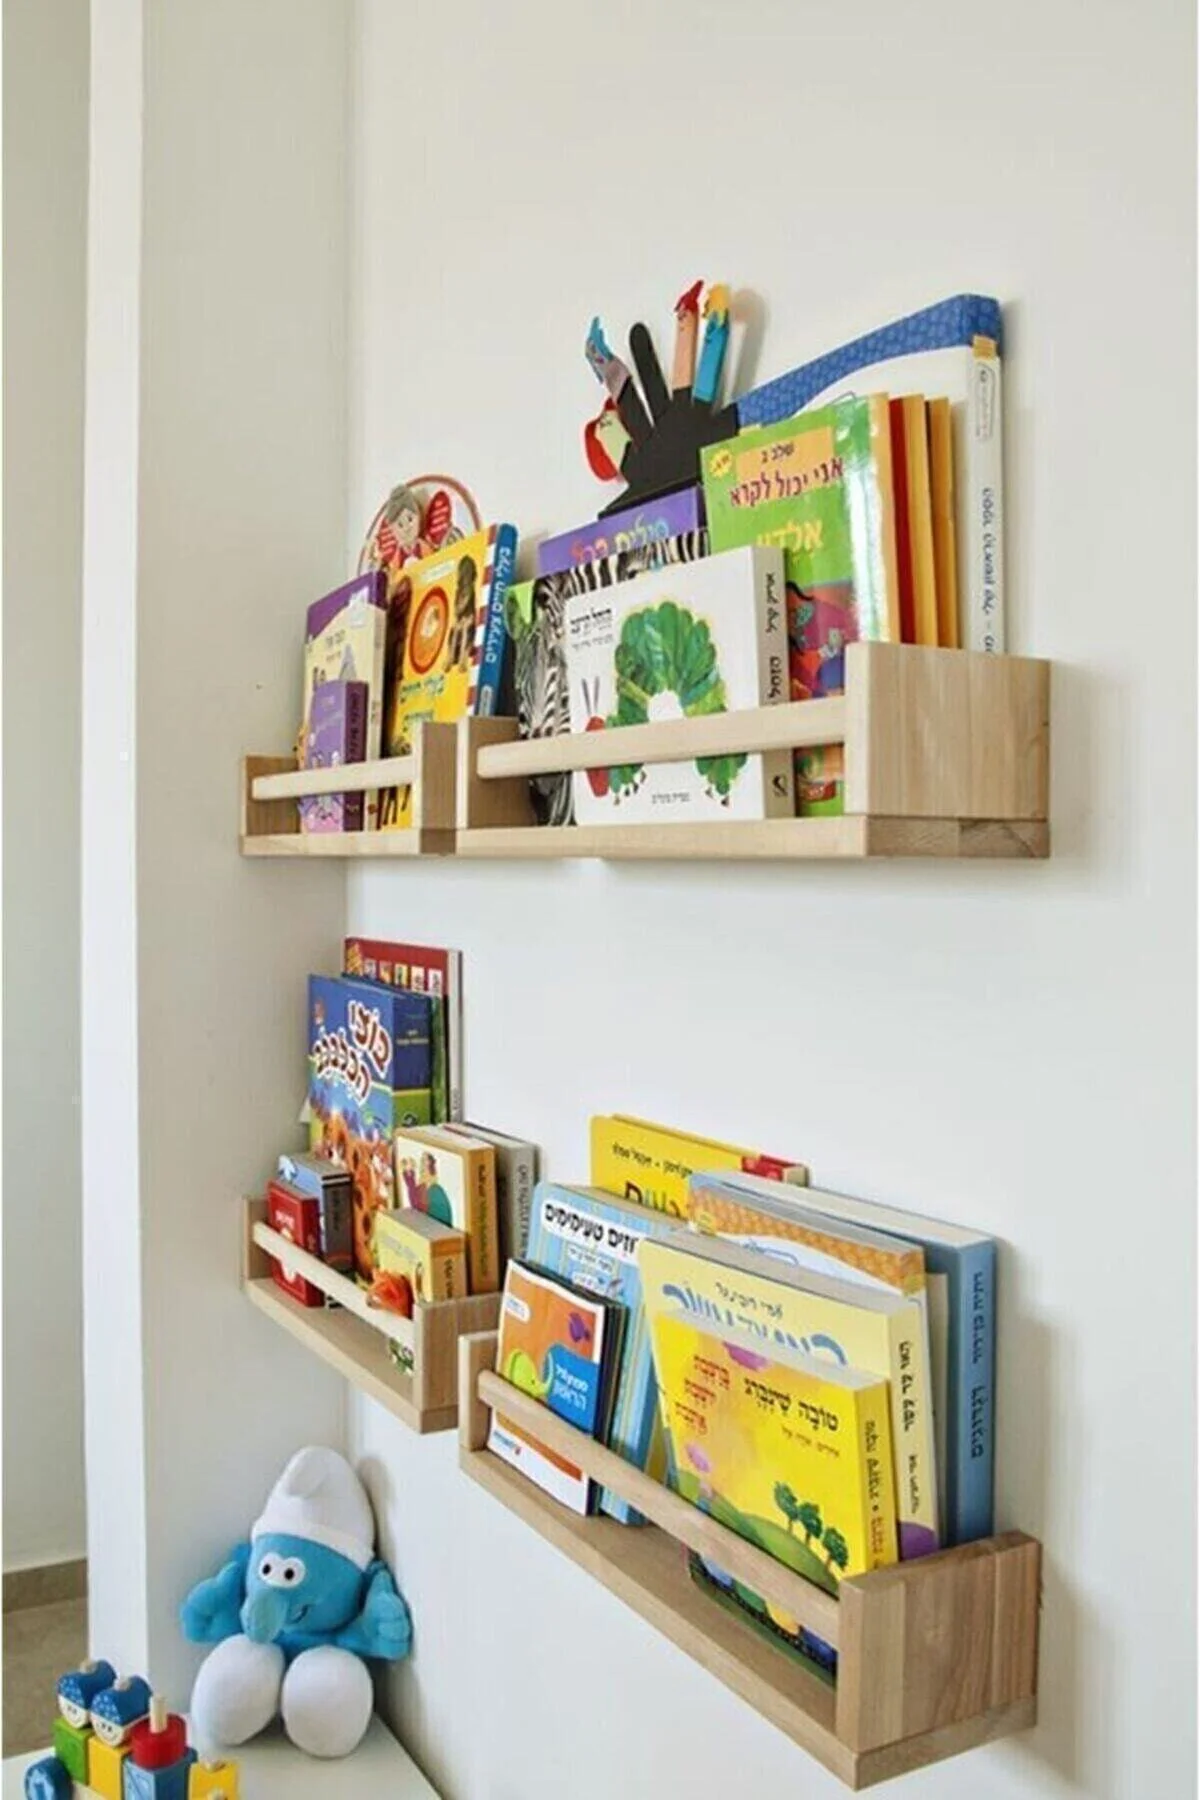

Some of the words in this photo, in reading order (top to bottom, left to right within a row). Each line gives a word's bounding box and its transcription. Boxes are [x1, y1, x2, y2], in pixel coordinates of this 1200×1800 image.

[776, 469, 809, 497] יכול
[814, 457, 843, 482] אני
[981, 487, 994, 528] הספר
[496, 546, 512, 579] בעלי
[981, 532, 995, 586] הראשון
[491, 580, 506, 614] חיים
[982, 588, 996, 615] שלי
[484, 615, 502, 664] צעירים
[767, 655, 782, 700] הזחל
